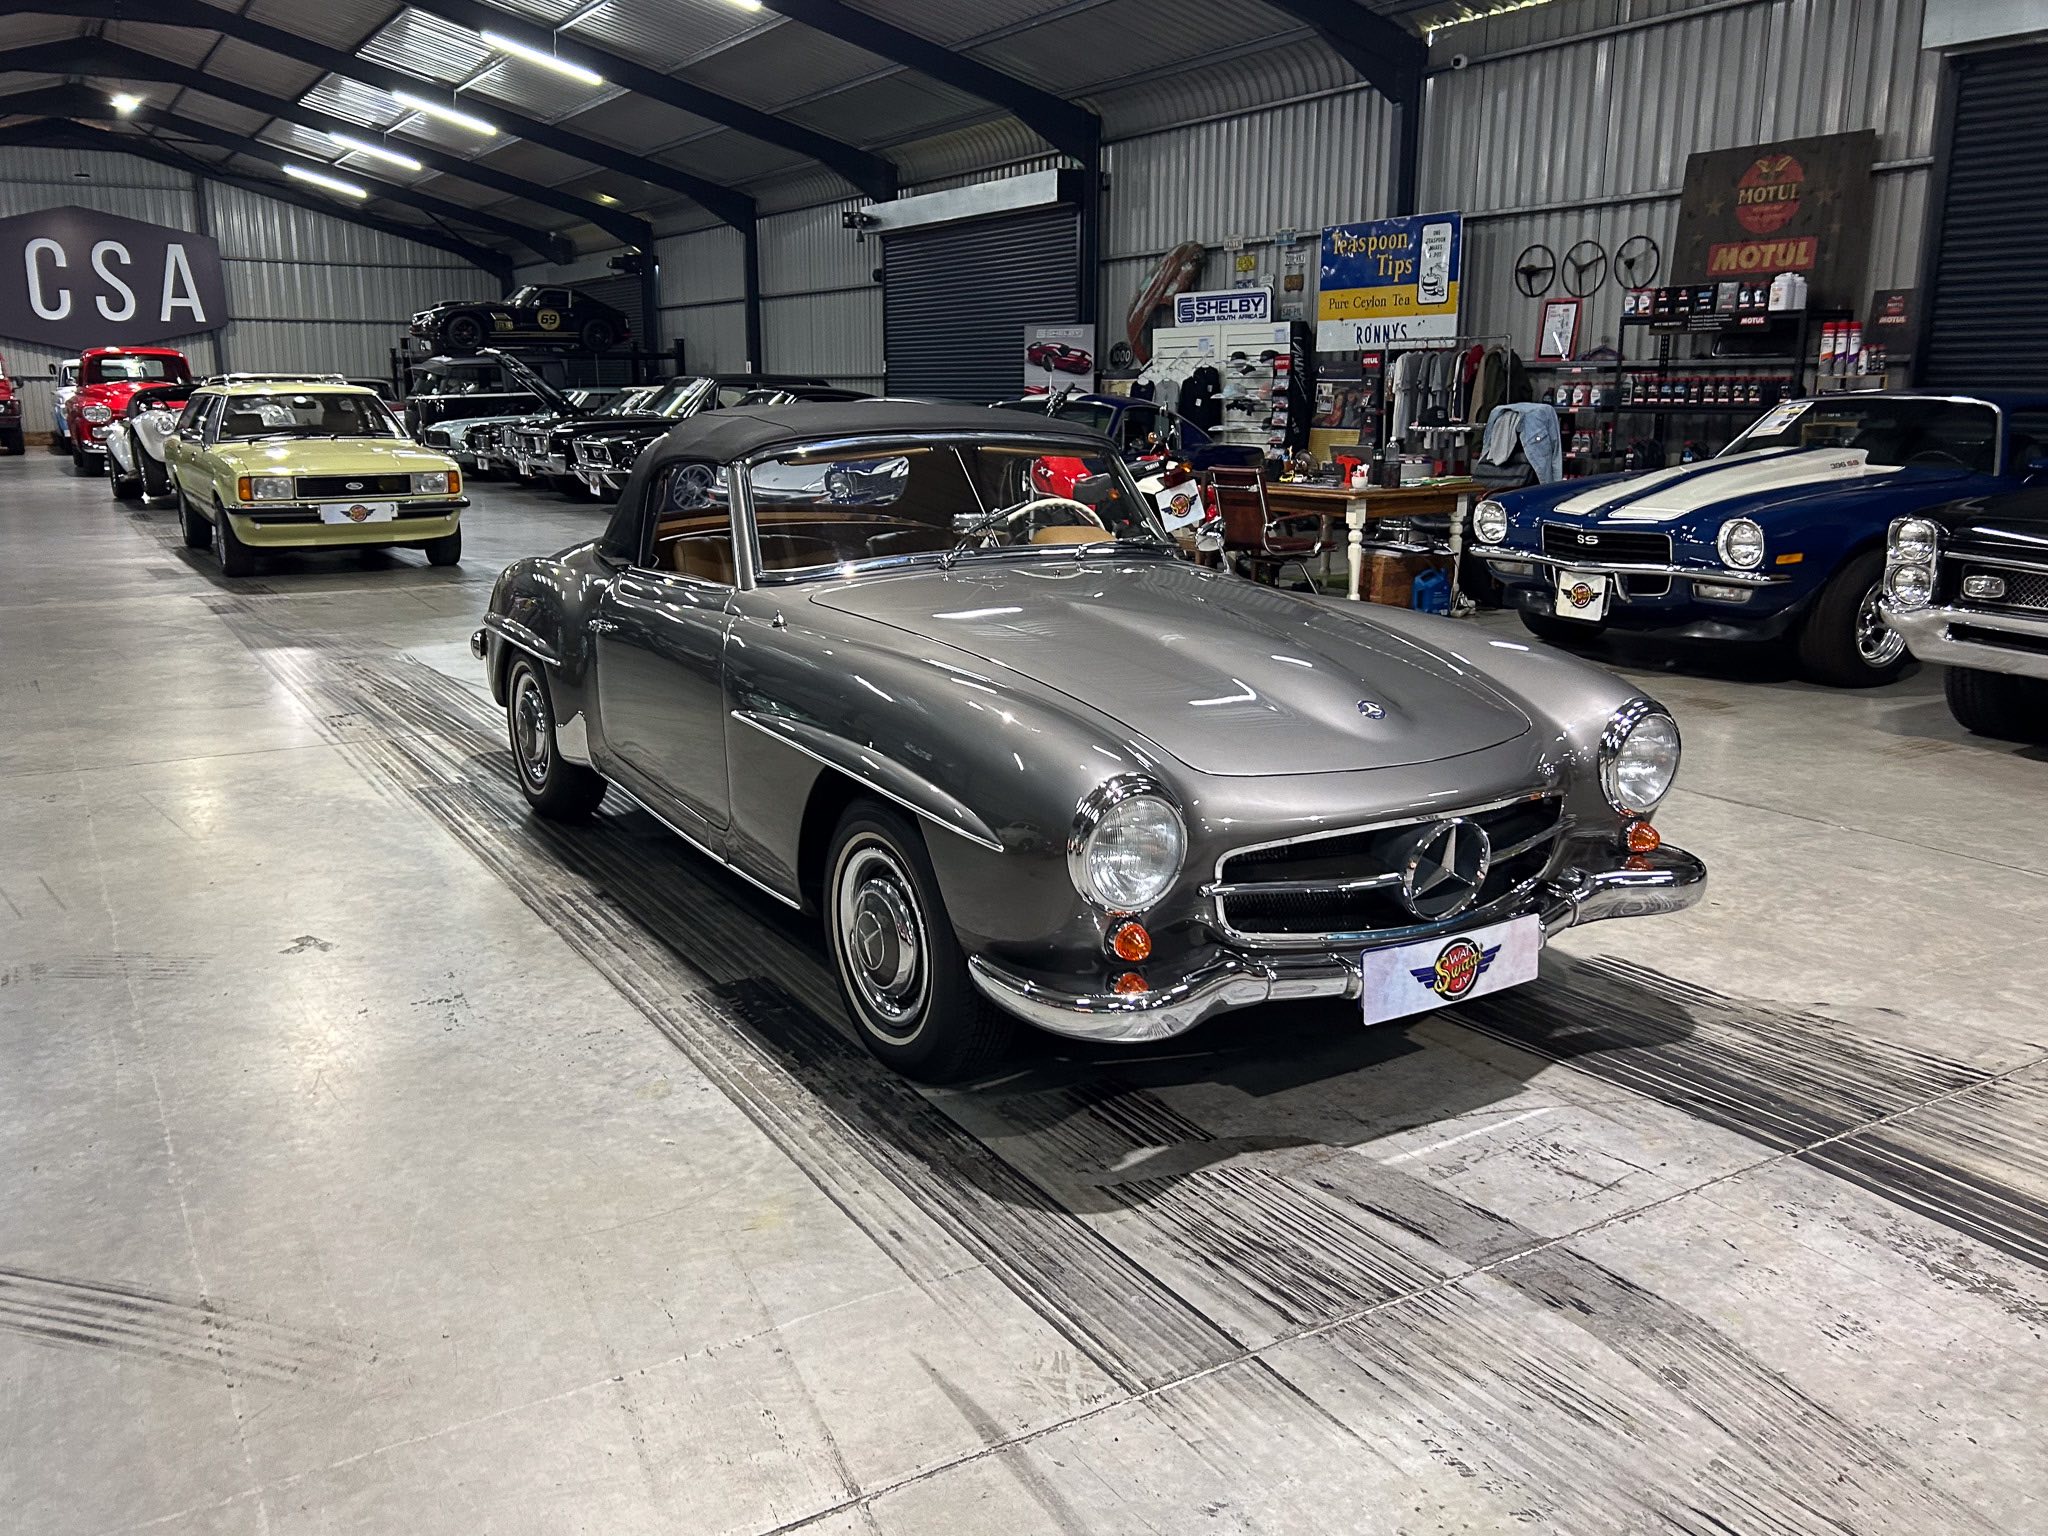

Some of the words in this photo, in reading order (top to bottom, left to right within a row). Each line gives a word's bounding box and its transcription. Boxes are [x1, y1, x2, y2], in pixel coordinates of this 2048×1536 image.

[1738, 184, 1800, 205] MOTUL
[1332, 231, 1408, 259] Teaspoon
[1711, 241, 1809, 271] MOTUL
[1377, 254, 1412, 283] Tips
[25, 238, 206, 323] CSA
[1196, 298, 1263, 315] SHELBY
[1329, 298, 1349, 310] Pure
[1353, 296, 1387, 311] Ceylon
[1392, 294, 1410, 306] Tea
[541, 314, 557, 325] 69
[1740, 316, 1765, 325] MOTUL
[1356, 323, 1407, 345] RONNYS
[1037, 466, 1055, 478] XT
[1577, 534, 1599, 545] SS
[1449, 941, 1474, 964] WAT
[1455, 973, 1471, 988] JY
